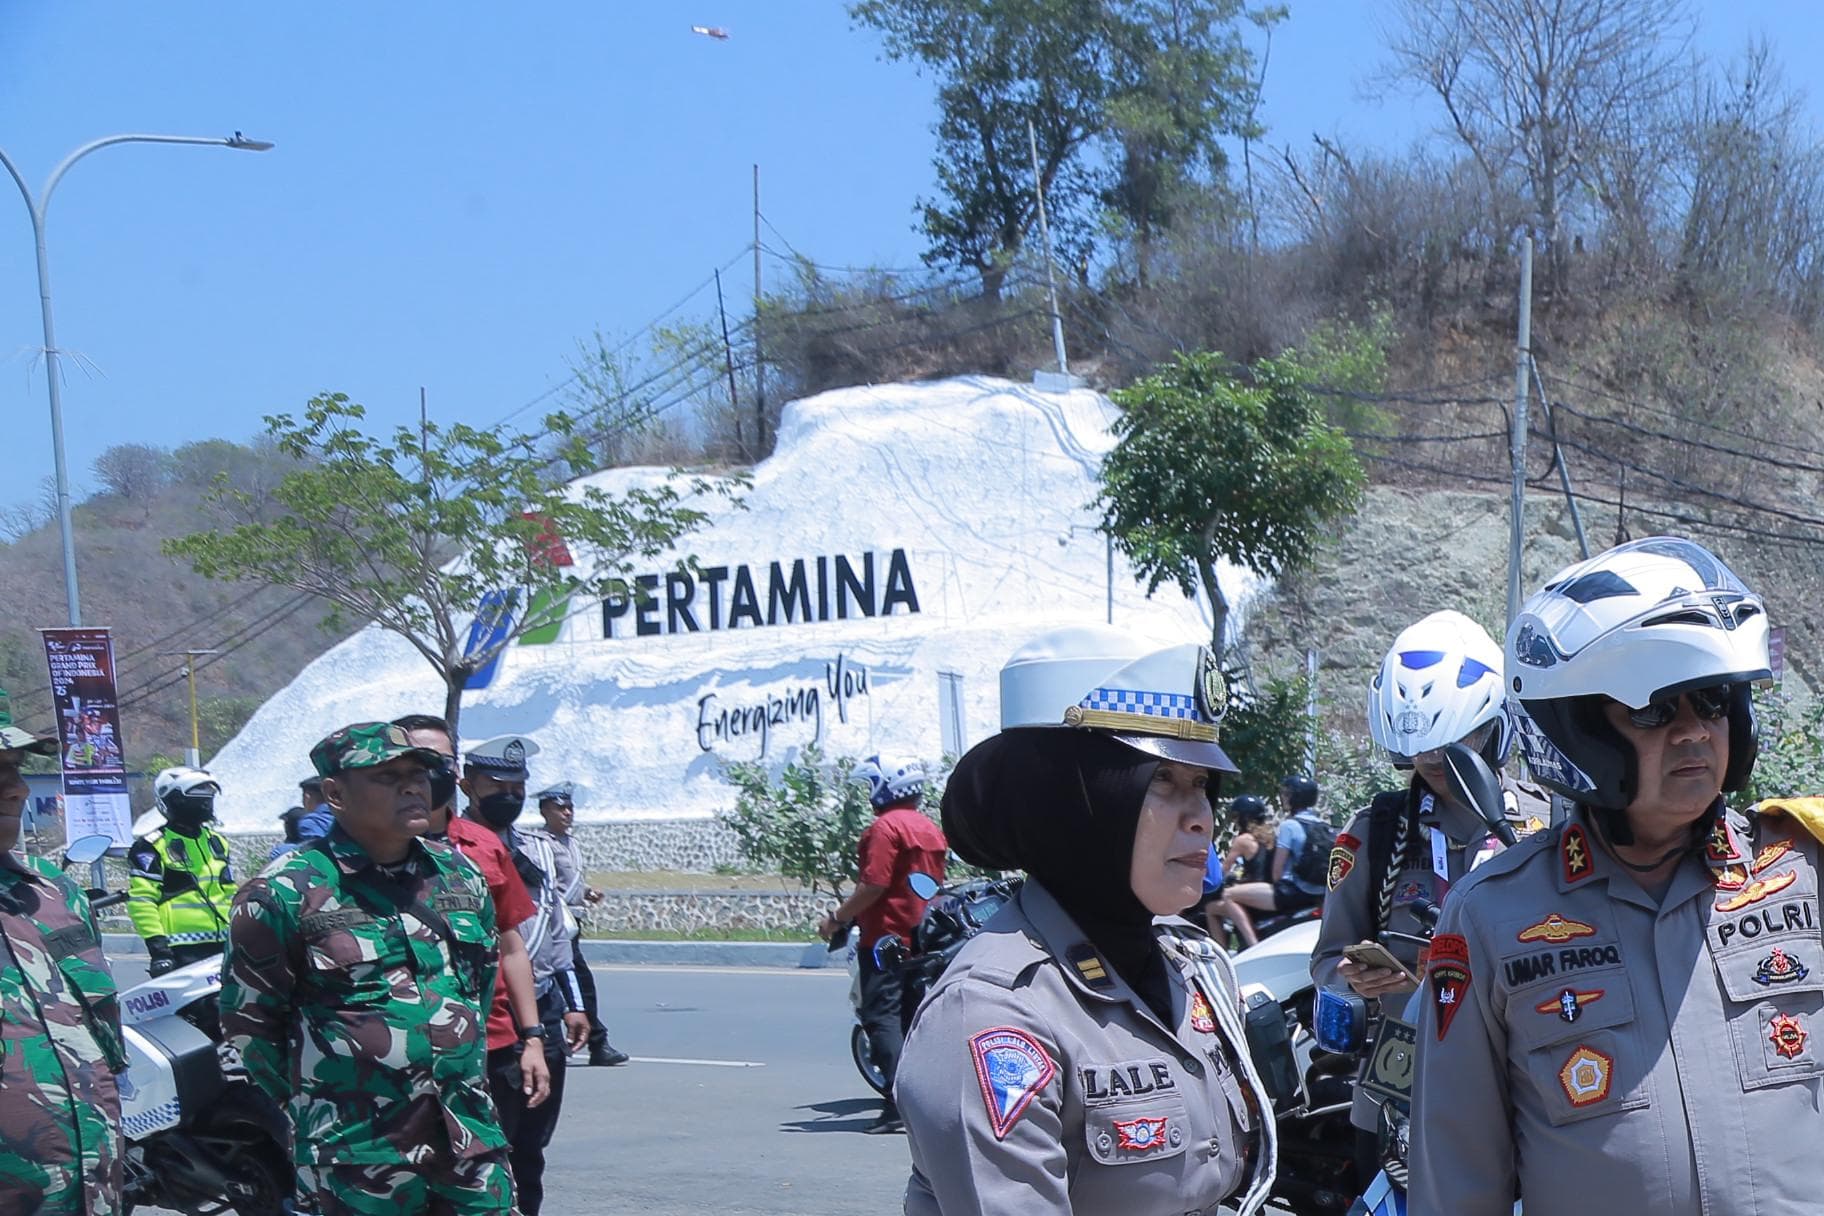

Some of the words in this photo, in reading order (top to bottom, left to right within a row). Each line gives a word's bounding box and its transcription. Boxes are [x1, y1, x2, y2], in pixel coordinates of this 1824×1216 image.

[603, 549, 920, 638] PERTAMINA
[696, 693, 820, 760] Energizing
[826, 653, 869, 723] You
[1717, 900, 1813, 947] POLRI
[1504, 952, 1556, 988] UMAR
[1559, 945, 1622, 973] FAROQ
[125, 990, 170, 1016] POLISI
[1084, 1062, 1175, 1099] LALE
